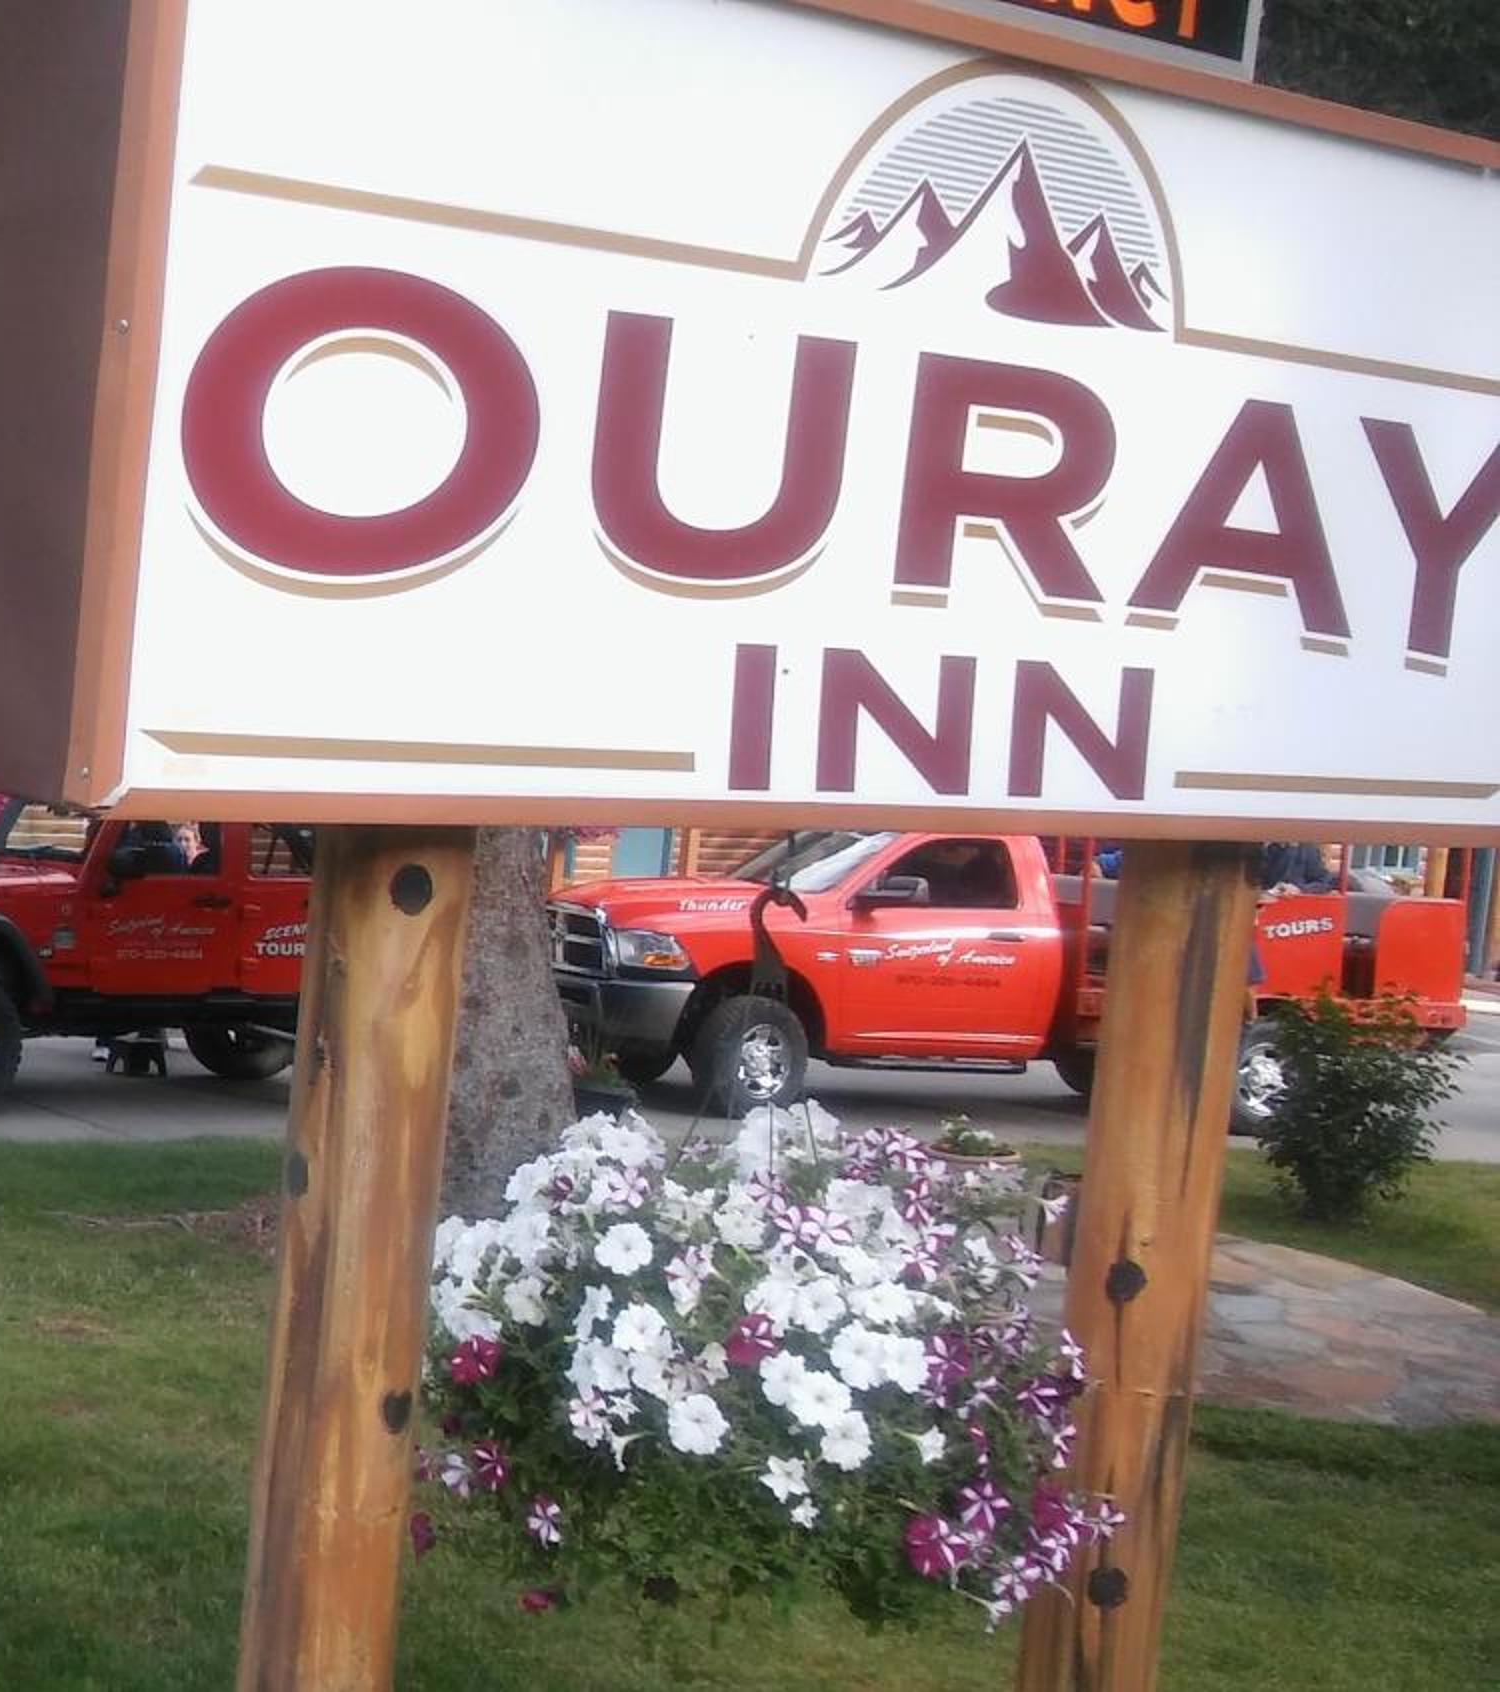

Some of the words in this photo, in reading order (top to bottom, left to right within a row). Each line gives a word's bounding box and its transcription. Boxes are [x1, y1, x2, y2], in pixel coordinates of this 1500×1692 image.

[181, 264, 1500, 674] OURAY
[727, 643, 1156, 801] INN
[679, 897, 748, 912] Thunder
[1264, 916, 1333, 939] TOURS
[254, 942, 307, 957] TOUR
